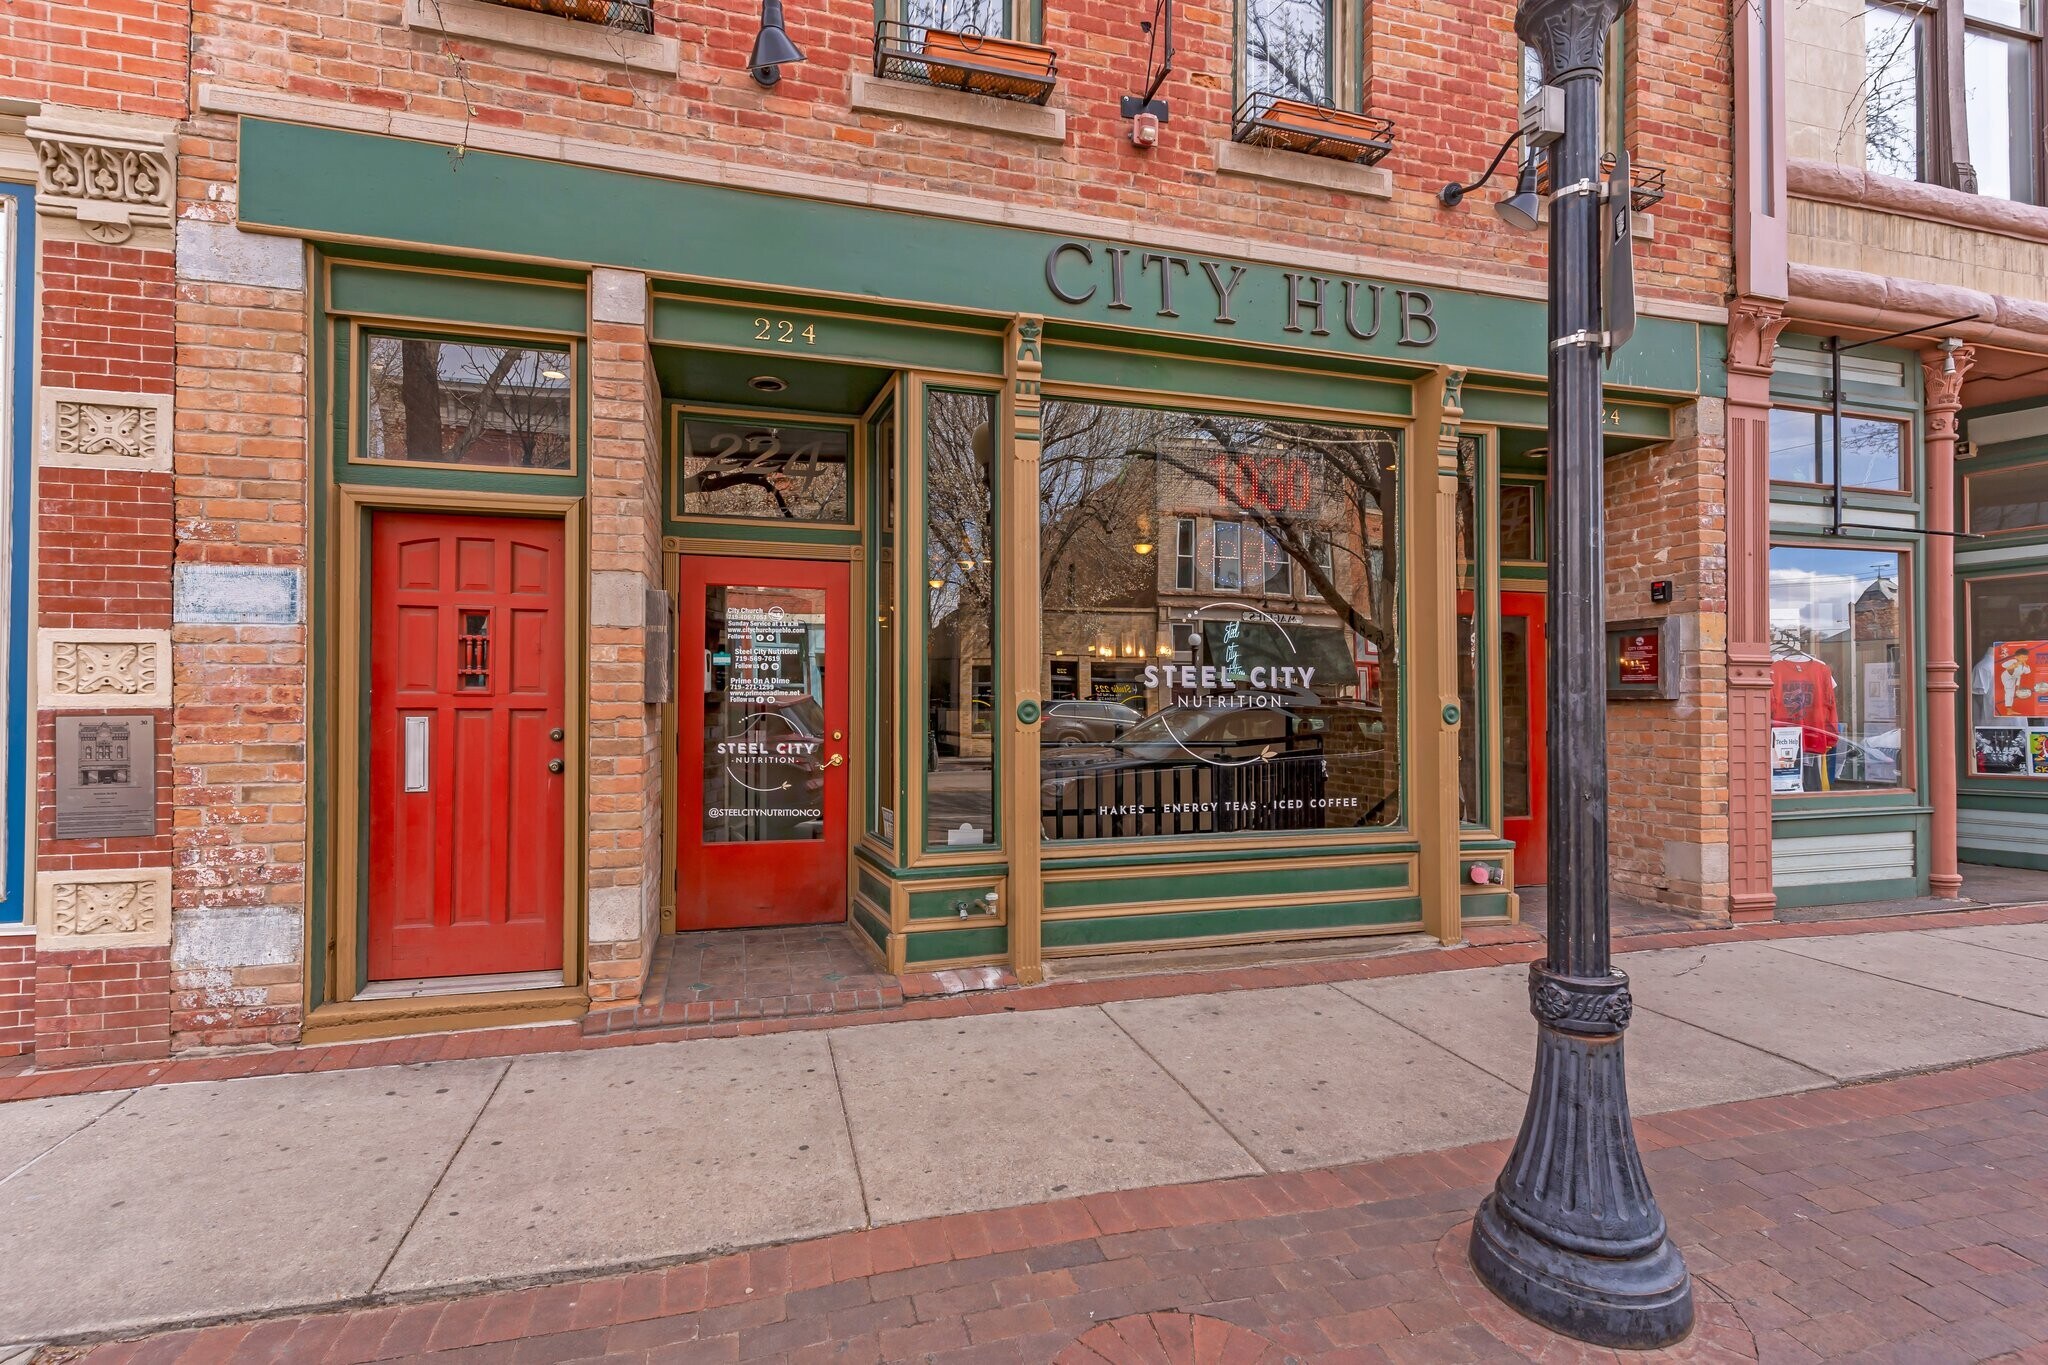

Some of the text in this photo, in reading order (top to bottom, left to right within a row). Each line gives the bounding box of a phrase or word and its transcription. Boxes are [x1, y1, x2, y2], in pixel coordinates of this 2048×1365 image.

[1046, 242, 1439, 347] CITY HUB
[754, 318, 816, 345] 224
[705, 433, 828, 493] 224
[1197, 540, 1277, 576] OPEN
[754, 648, 766, 656] City
[1143, 665, 1316, 689] STEEL CITY
[717, 743, 815, 754] STEEL CITY
[708, 808, 821, 818] @STEELCITYNUTRITIONCO
[1099, 804, 1145, 816] HAKES
[1163, 802, 1218, 814] ENERGY
[1225, 801, 1257, 811] TEAS
[1273, 800, 1303, 809] ICED
[1310, 798, 1358, 808] COFFEE
